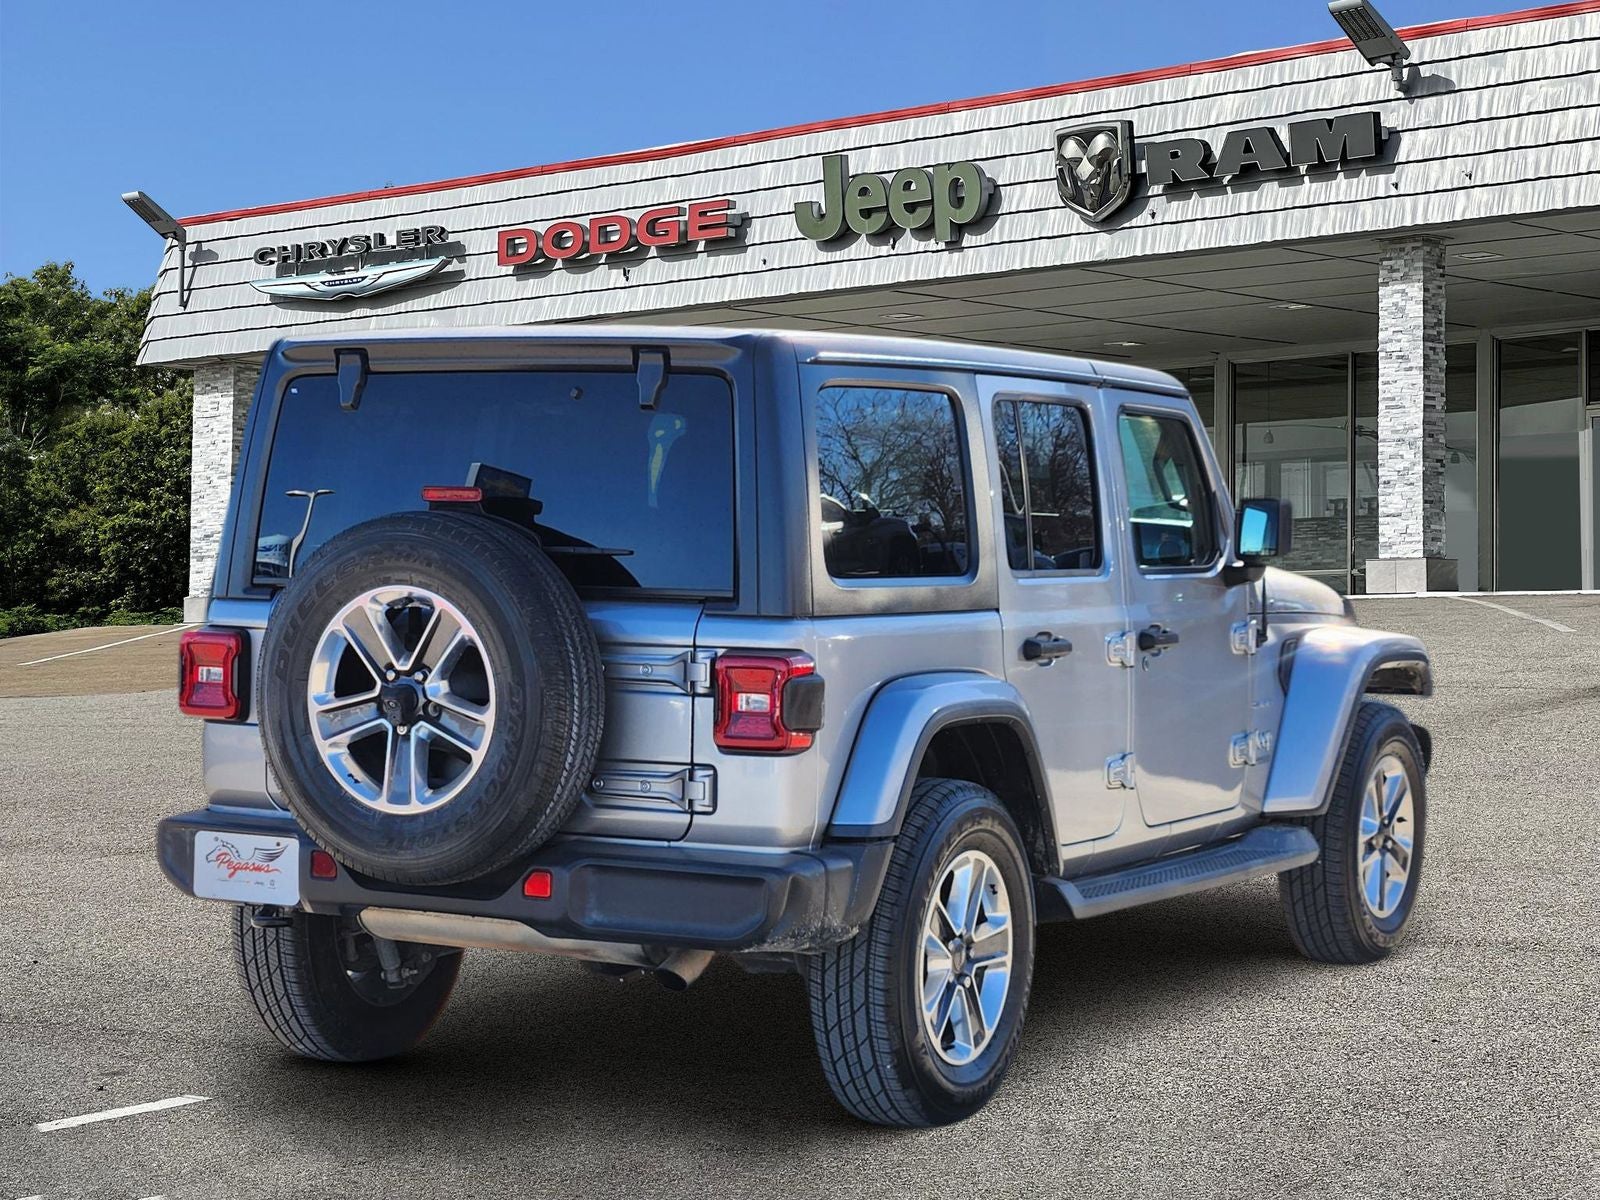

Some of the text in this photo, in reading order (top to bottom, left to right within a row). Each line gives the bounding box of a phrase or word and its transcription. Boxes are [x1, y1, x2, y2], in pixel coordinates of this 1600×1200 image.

[1144, 111, 1380, 186] RAM
[795, 154, 984, 242] Jeep
[254, 224, 449, 265] CHRYSLER
[497, 199, 735, 267] DODGE
[324, 278, 363, 286] CHRYSLER
[216, 852, 281, 879] Pegasus
